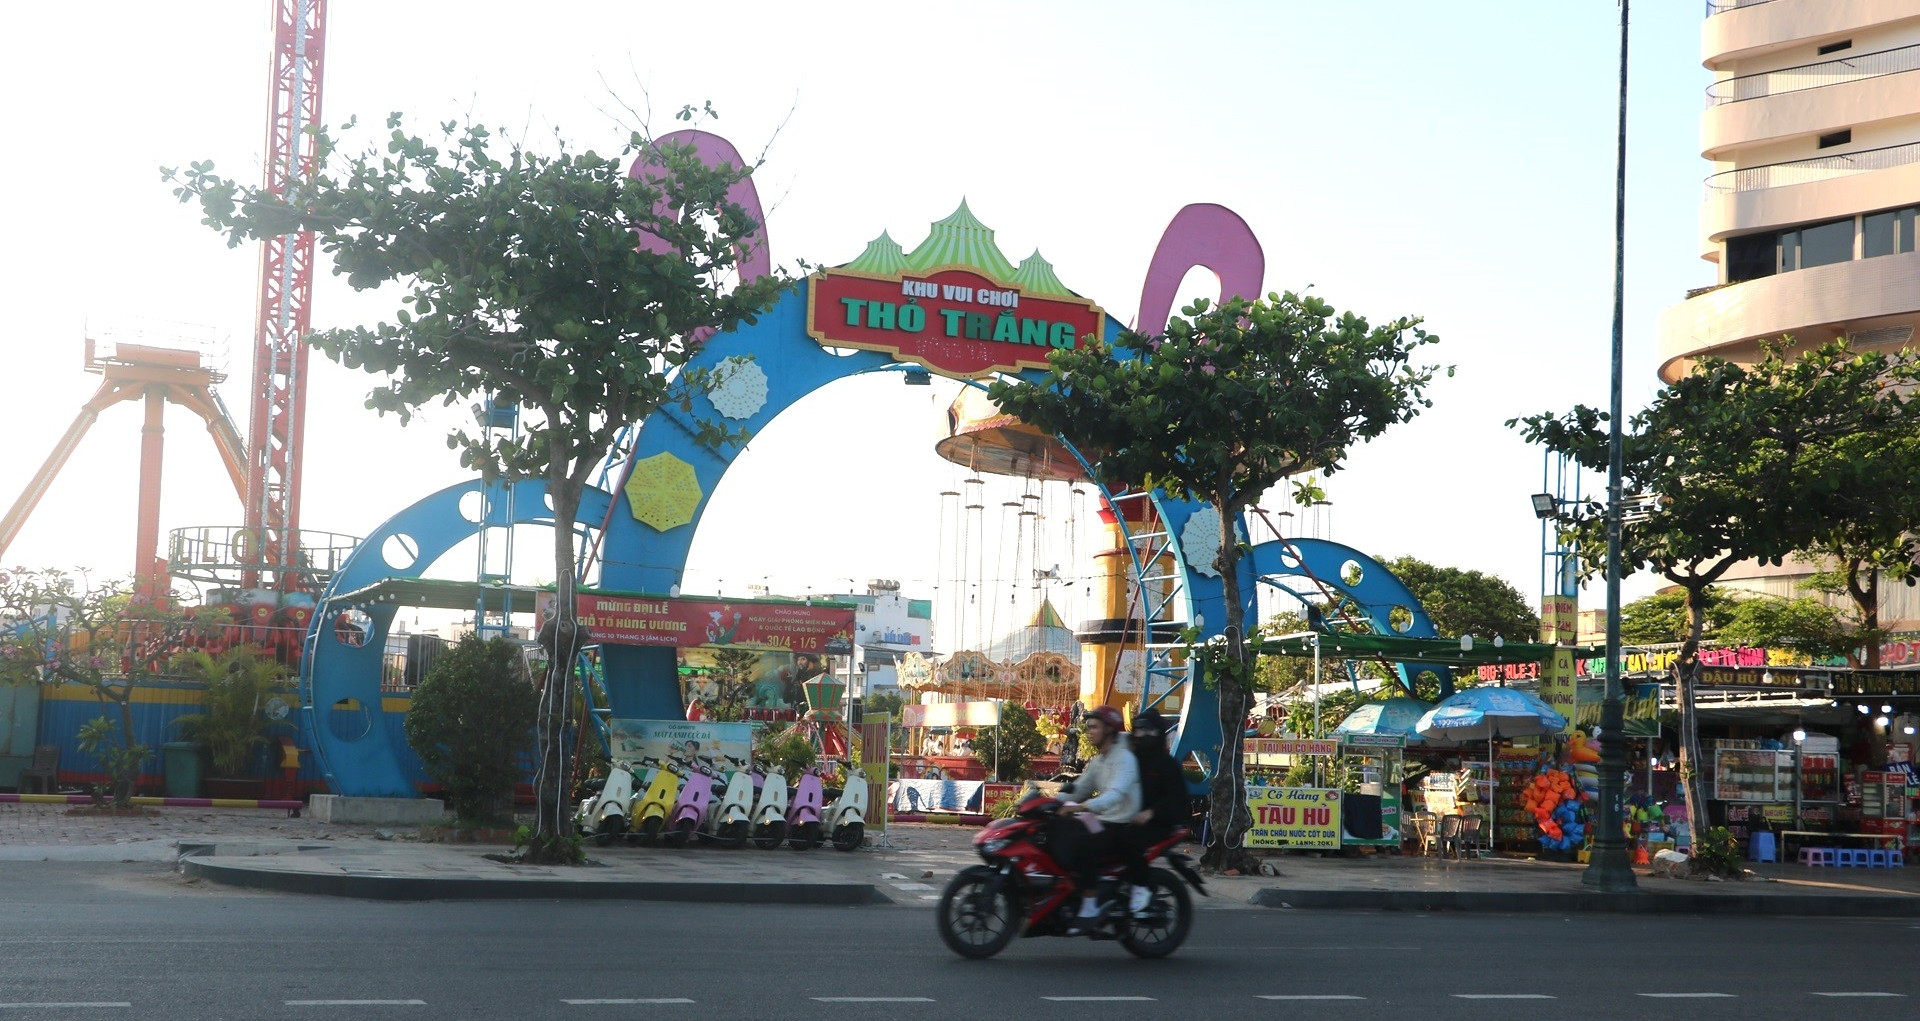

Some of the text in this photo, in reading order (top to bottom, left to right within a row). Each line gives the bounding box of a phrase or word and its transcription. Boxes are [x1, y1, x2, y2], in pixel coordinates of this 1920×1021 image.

[902, 280, 1019, 309] KHU VUI CHƠI
[841, 297, 1076, 350] THỎ TRẮNG
[596, 600, 669, 616] MỪNG ĐẠI LỄ
[616, 616, 647, 630] HÙNG
[649, 620, 687, 632] VƯƠNG
[767, 635, 790, 648] 30/4
[800, 637, 817, 649] 1/5
[1702, 670, 1734, 686] ĐẬU
[1737, 670, 1758, 684] HỦ
[1267, 789, 1284, 800] Cô
[1303, 803, 1331, 826] HỦ
